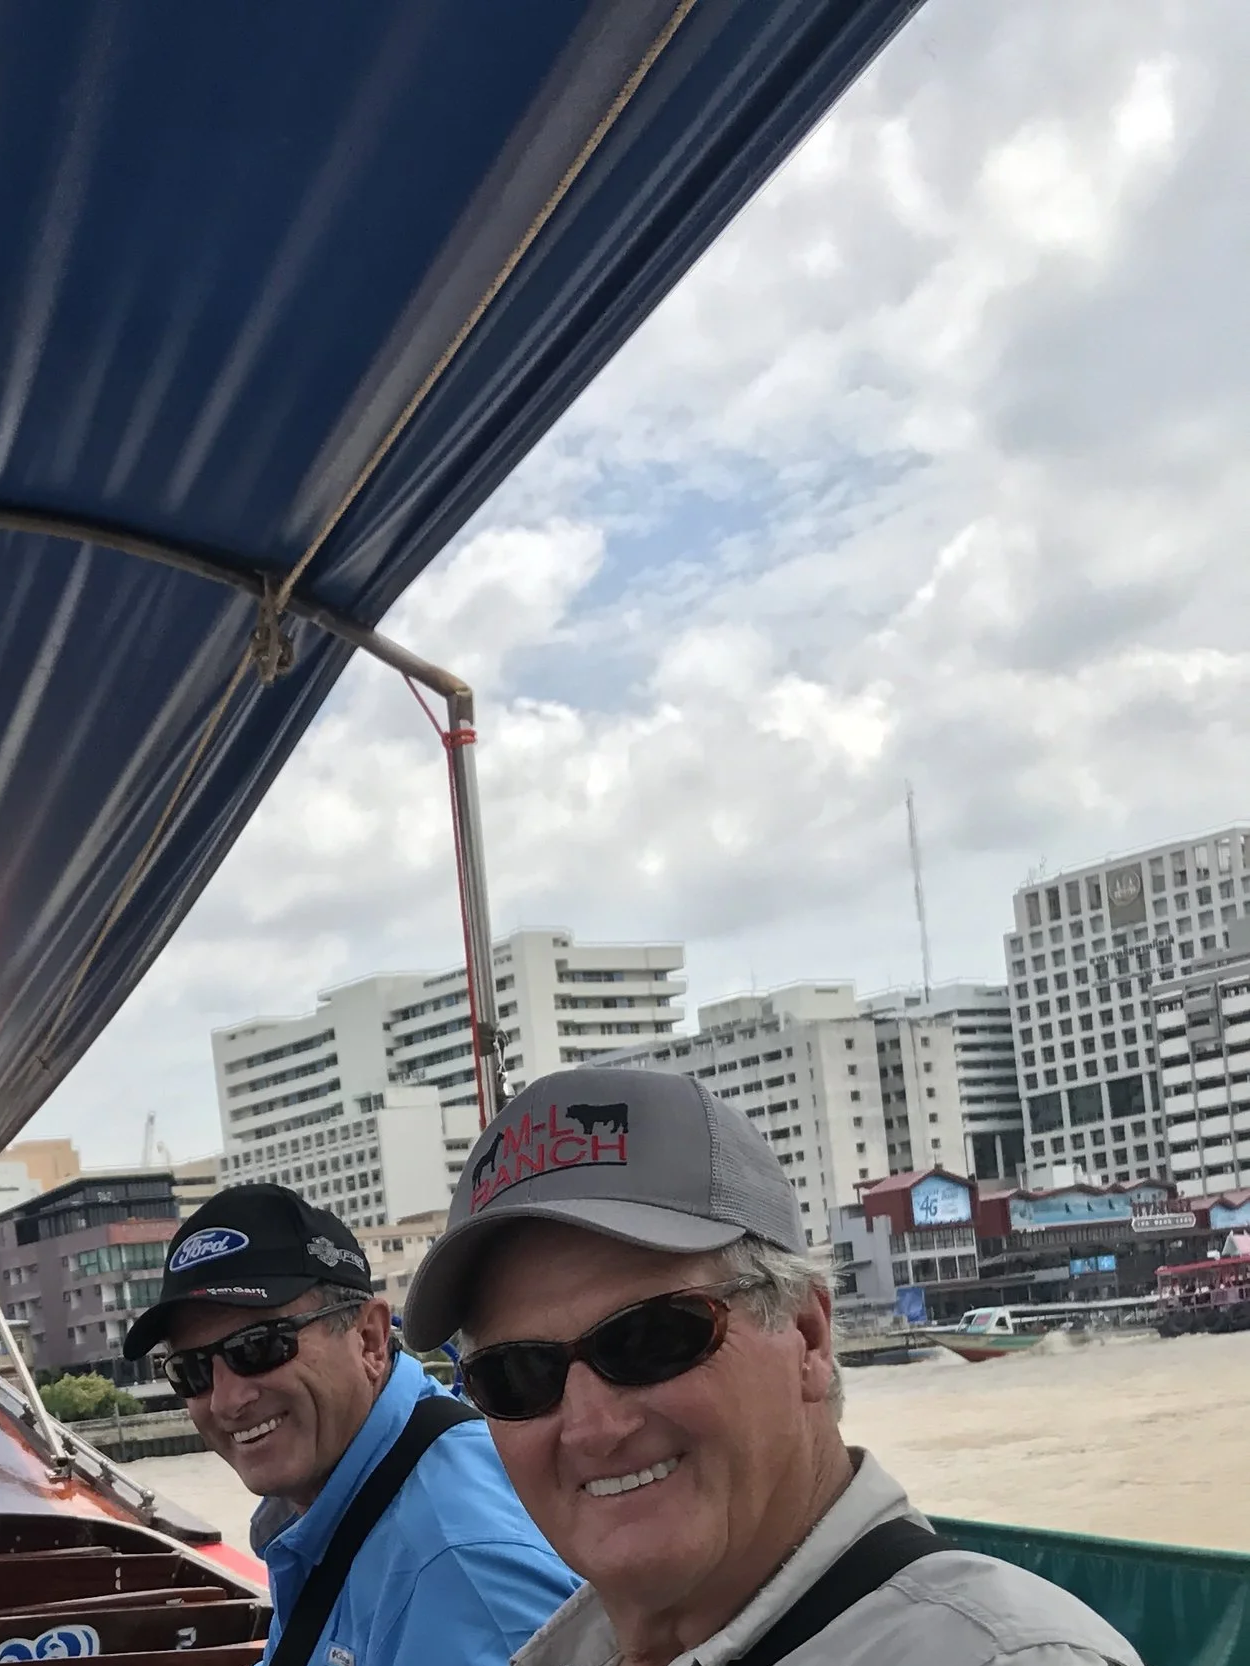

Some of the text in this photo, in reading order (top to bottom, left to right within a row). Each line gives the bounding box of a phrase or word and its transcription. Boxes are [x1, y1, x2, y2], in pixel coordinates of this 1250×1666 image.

[503, 1104, 574, 1159] M-L
[469, 1134, 627, 1216] RANCH
[919, 1195, 938, 1221] 4G
[178, 1232, 230, 1264] Ford
